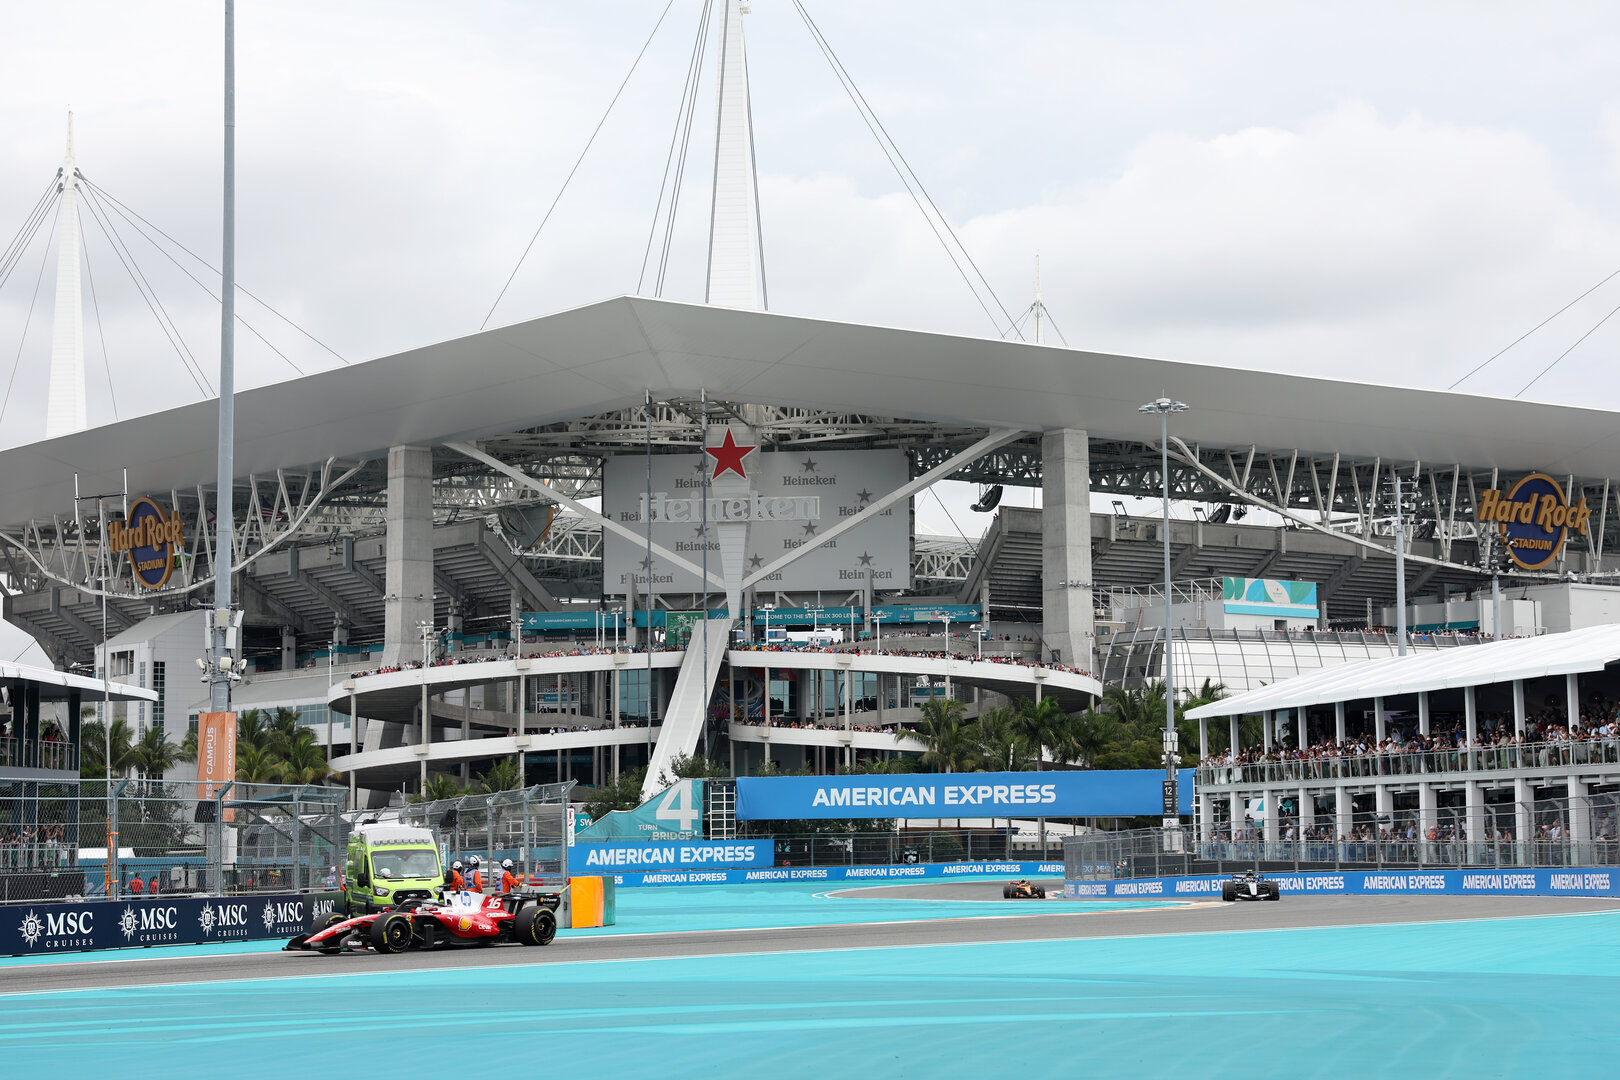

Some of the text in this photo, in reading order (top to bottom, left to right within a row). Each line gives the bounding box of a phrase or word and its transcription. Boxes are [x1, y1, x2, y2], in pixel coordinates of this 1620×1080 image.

[783, 476, 836, 486] Heineken
[640, 490, 818, 523] Heineken
[839, 506, 892, 516] Heien
[1478, 489, 1590, 535] Hard Rock
[108, 510, 185, 552] Hard Rock
[676, 542, 720, 552] Heineke
[784, 540, 836, 549] Heien
[1512, 538, 1552, 550] STADIUM
[138, 558, 165, 571] STADIUM
[620, 574, 673, 584] Hineken
[839, 570, 892, 580] Heinken
[206, 727, 214, 774] CAMPUS
[812, 785, 1056, 806] AMERICAN EXPRESS
[1164, 786, 1172, 795] 12
[656, 780, 698, 830] 4
[652, 832, 692, 840] BRIDGE
[586, 846, 754, 865] AMERICAN EXPRESS
[746, 870, 827, 880] AMERICAN EXPRESS
[846, 866, 925, 876] AMERICAN EXPRESS
[943, 865, 983, 873] AMERICAN
[643, 873, 726, 883] AMERICAN EXPRESS
[1306, 876, 1344, 889] EXPRESS
[1364, 875, 1445, 889] AMERICAN EXPRESS
[1463, 875, 1535, 889] AMERICAN EXPRESS
[1551, 874, 1610, 889] AMERICAN EXPRESS
[1114, 882, 1162, 894] AMERICAN EXPRESS
[1176, 880, 1210, 892] AMERICAN
[320, 900, 334, 914] MSC
[486, 898, 502, 908] 16
[218, 905, 247, 925] MSC
[277, 902, 303, 922] MSC
[47, 912, 92, 935] MSC
[140, 907, 177, 930] MSC
[277, 926, 303, 934] CRUISES
[46, 939, 93, 947] CRUISES
[140, 933, 177, 941] CRUISES
